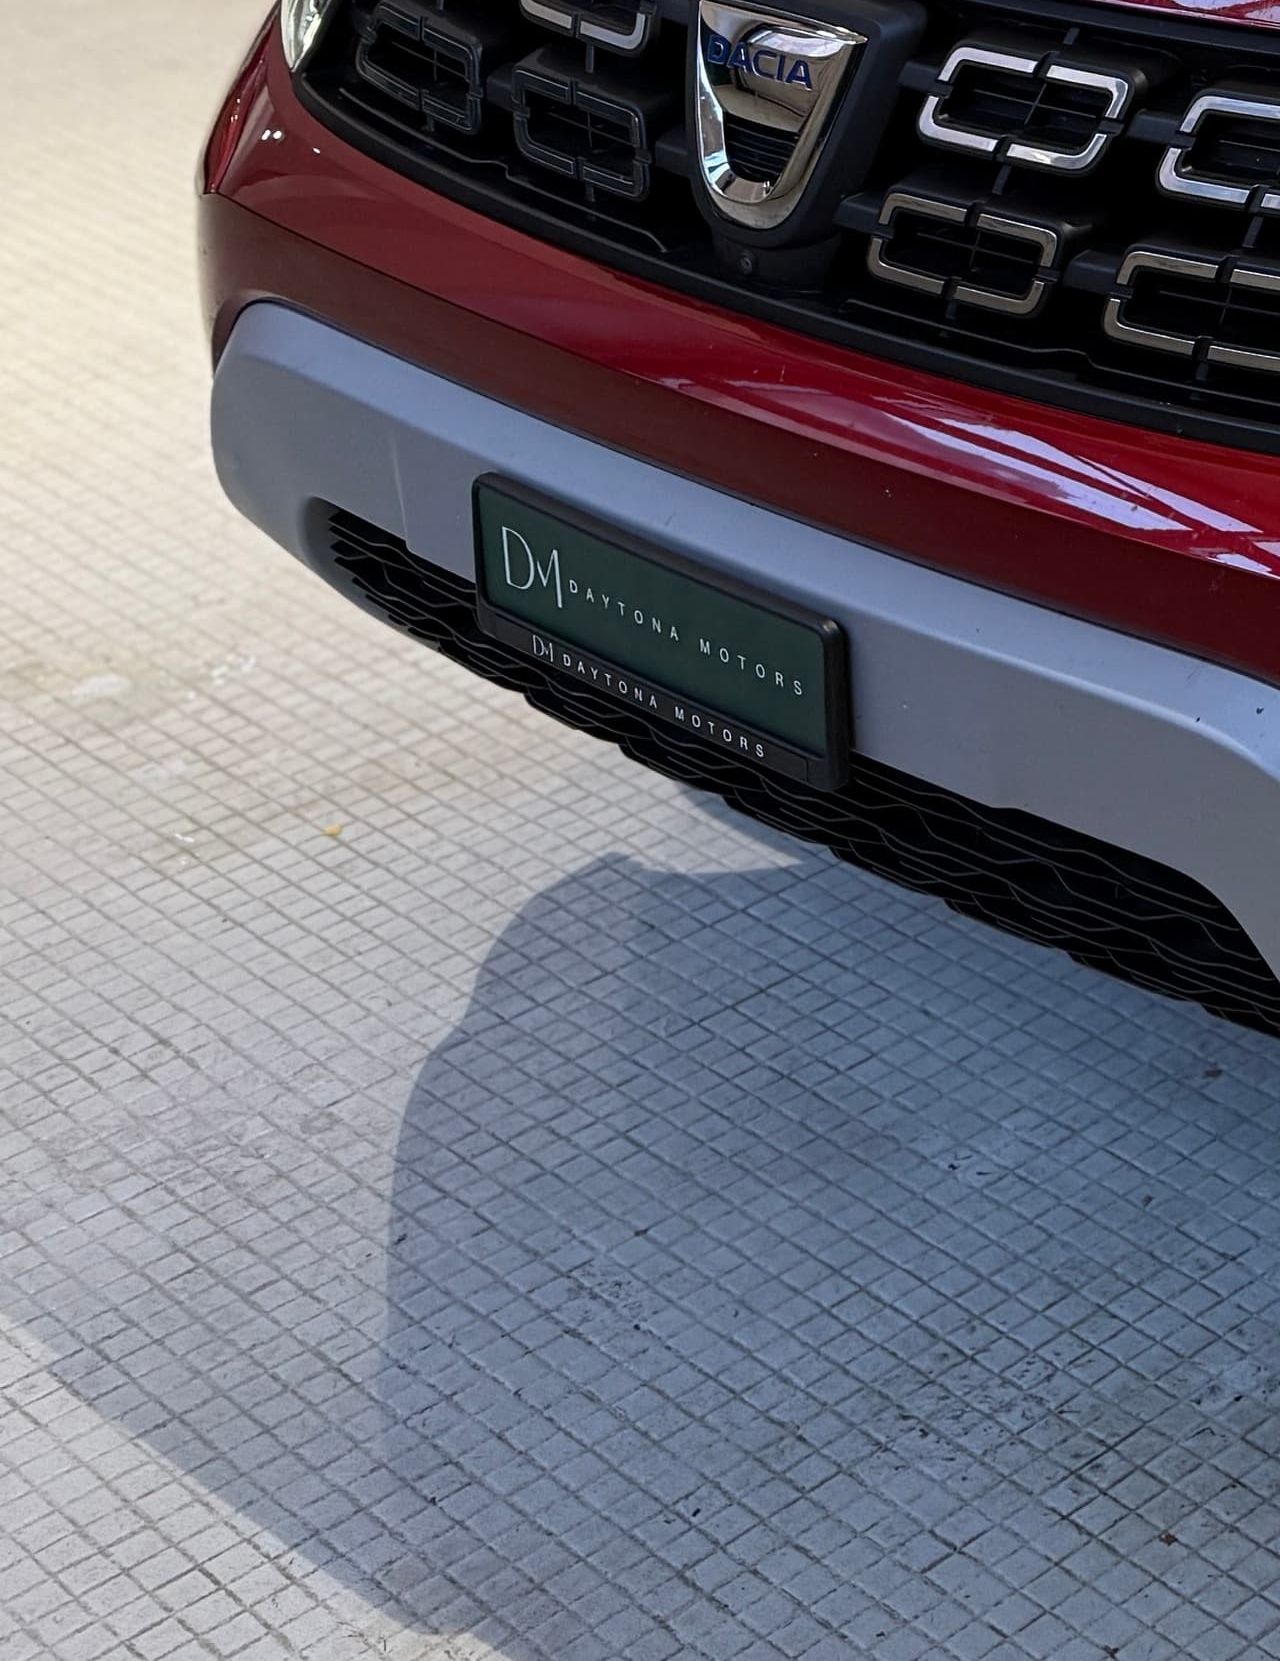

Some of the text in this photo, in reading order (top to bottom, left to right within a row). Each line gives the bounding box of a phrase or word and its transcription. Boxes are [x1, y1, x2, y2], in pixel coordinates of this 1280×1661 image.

[706, 34, 813, 91] DACIA
[568, 578, 679, 642] DAYTONA
[699, 638, 804, 697] MOTORS
[562, 653, 658, 710] DAYTONA
[674, 705, 765, 758] MOTORS
